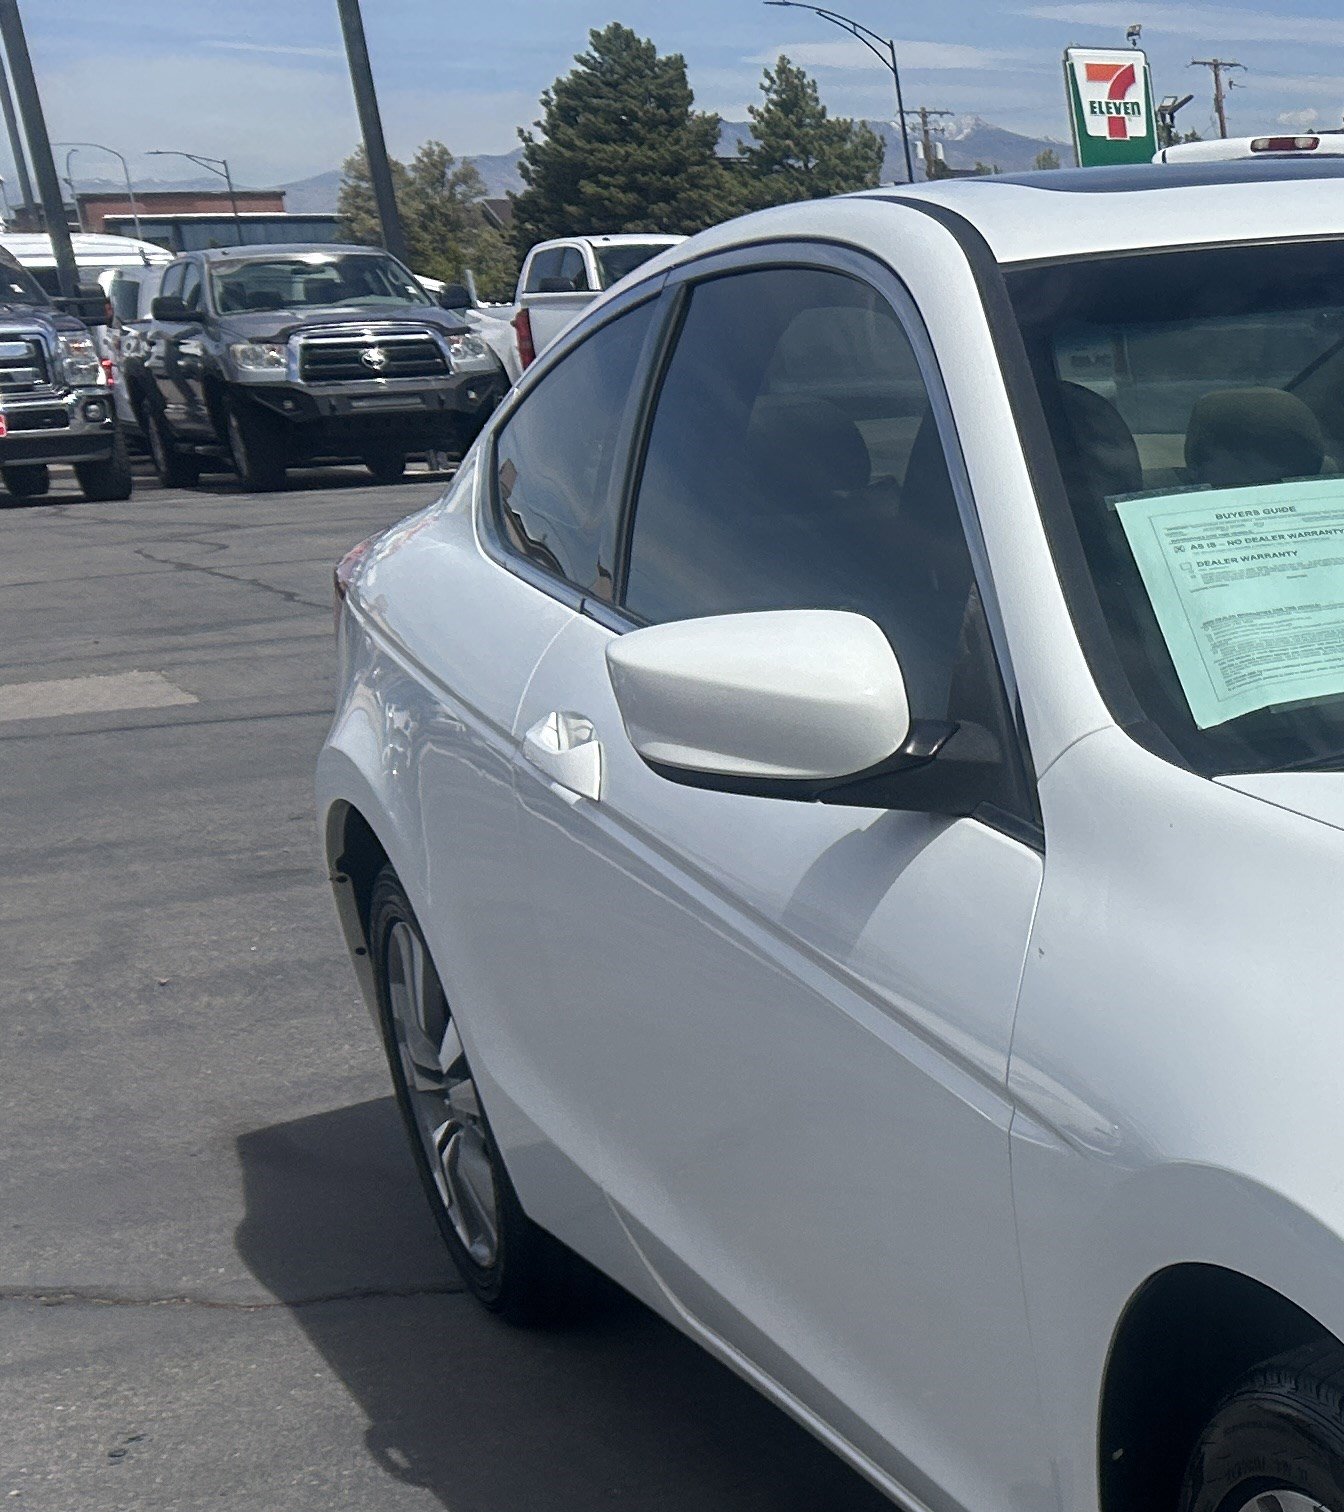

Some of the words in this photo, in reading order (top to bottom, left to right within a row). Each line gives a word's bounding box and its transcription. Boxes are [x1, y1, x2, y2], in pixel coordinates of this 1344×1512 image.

[1084, 62, 1136, 139] 7
[1215, 509, 1261, 520] BUYERS
[1262, 505, 1297, 515] GUIDE
[1226, 538, 1242, 546] NO
[1245, 533, 1285, 544] DEALER
[1287, 528, 1344, 540] WARRANTY
[1196, 557, 1238, 568] DEALER
[1239, 550, 1298, 563] WARRANTY
